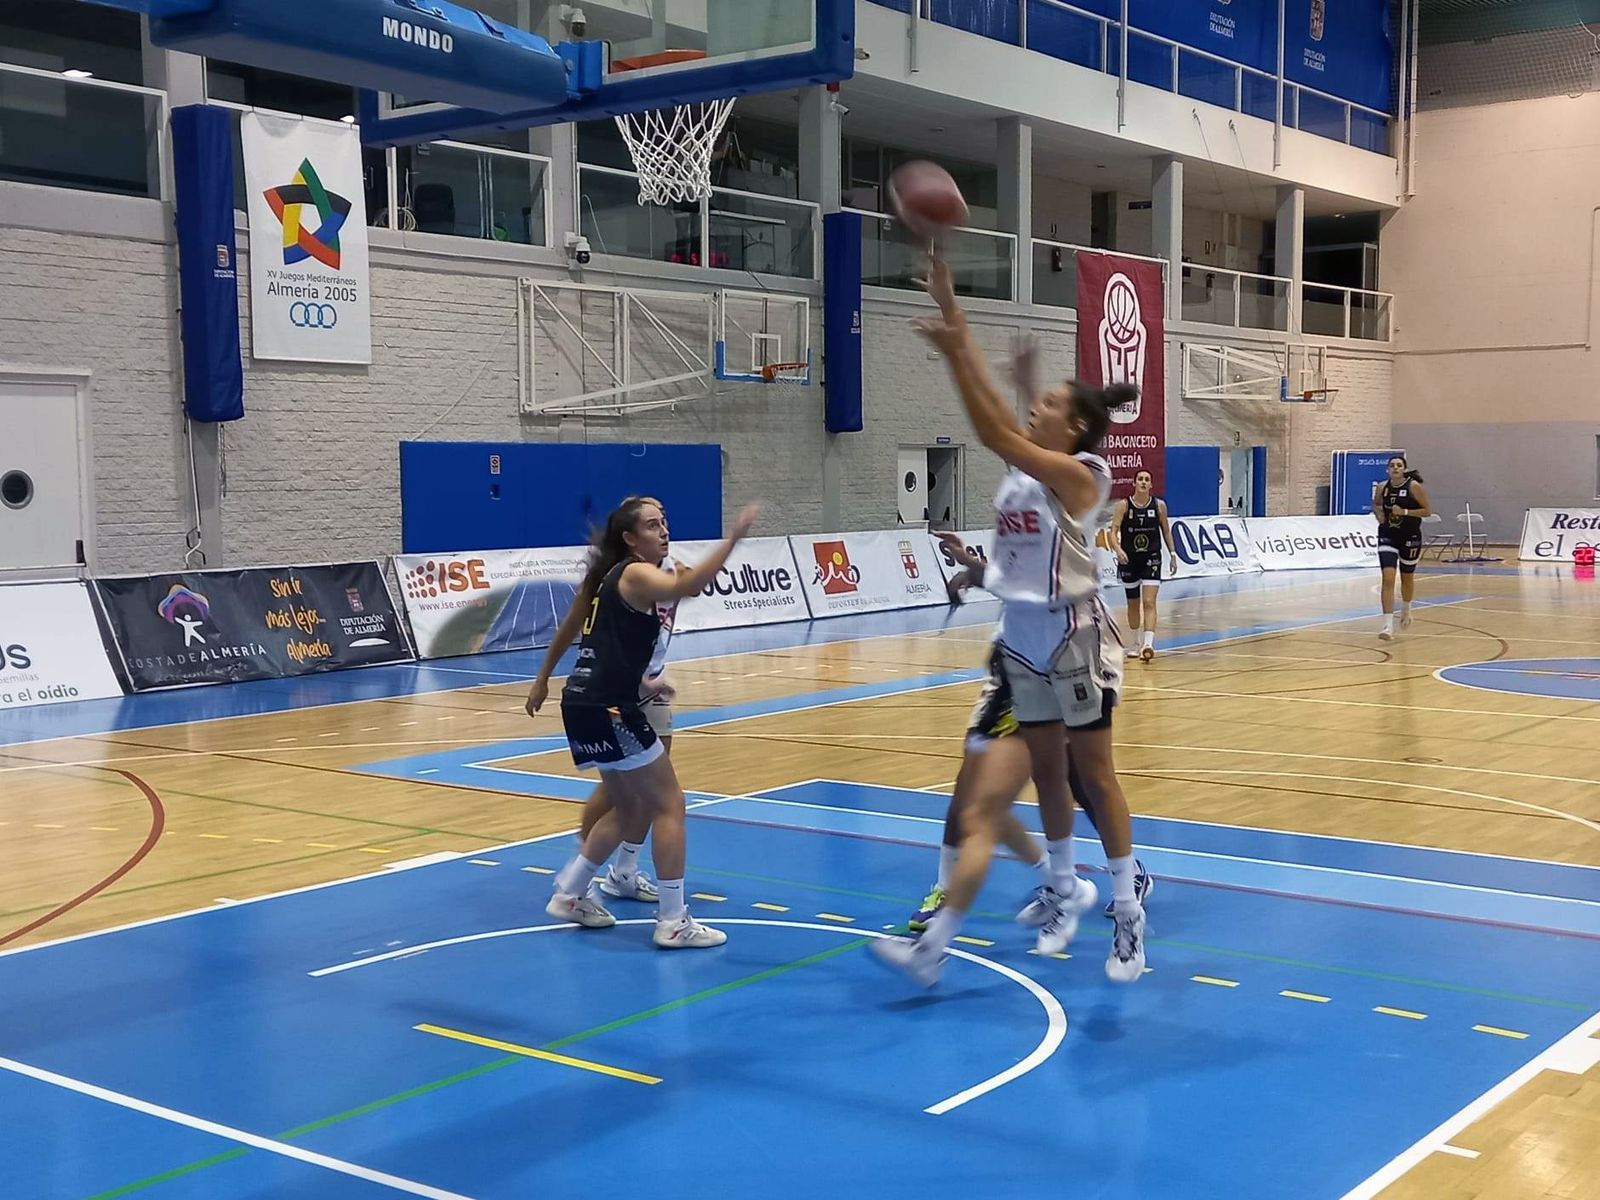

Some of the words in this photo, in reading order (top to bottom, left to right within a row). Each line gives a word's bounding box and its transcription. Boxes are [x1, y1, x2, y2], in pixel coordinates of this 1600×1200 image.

[383, 16, 453, 53] MONDO
[267, 270, 277, 279] XV
[279, 271, 305, 282] Juegos
[306, 274, 357, 286] Mediterráneos
[267, 281, 319, 299] Almería
[324, 286, 357, 302] 2005
[1106, 451, 1143, 468] ALMERÍA
[1549, 513, 1600, 530] Rest
[1256, 532, 1379, 556] viajesvertic
[1534, 534, 1564, 558] el
[438, 559, 490, 593] ISE
[270, 578, 291, 598] Sin
[724, 600, 752, 610] Stress
[753, 596, 795, 609] Specialists
[265, 609, 291, 629] más
[343, 627, 354, 635] DE
[354, 623, 386, 635] ALMERÍA
[18, 688, 32, 702] el
